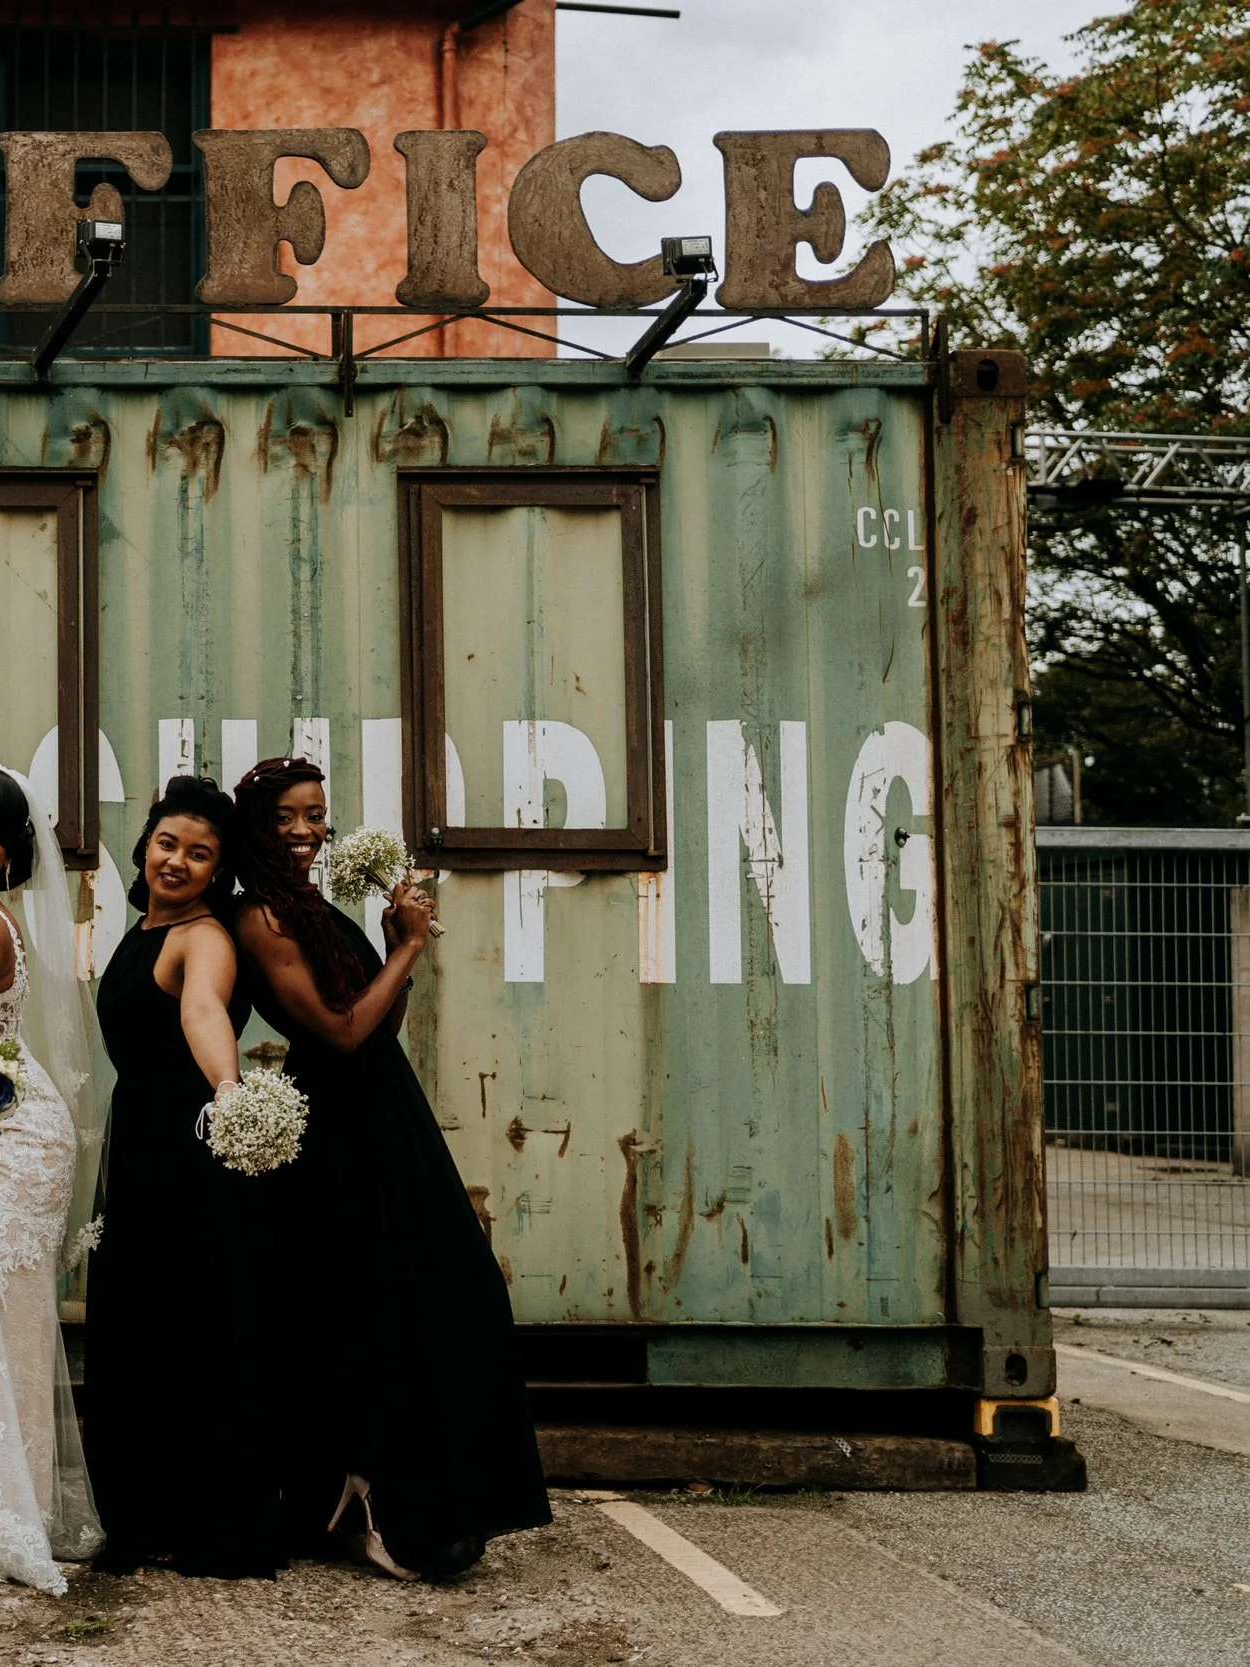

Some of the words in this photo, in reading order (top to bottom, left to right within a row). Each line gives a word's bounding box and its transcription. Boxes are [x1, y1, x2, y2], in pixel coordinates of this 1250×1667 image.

[857, 506, 926, 551] CCL
[907, 566, 927, 607] 2
[22, 717, 937, 985] SPPING
